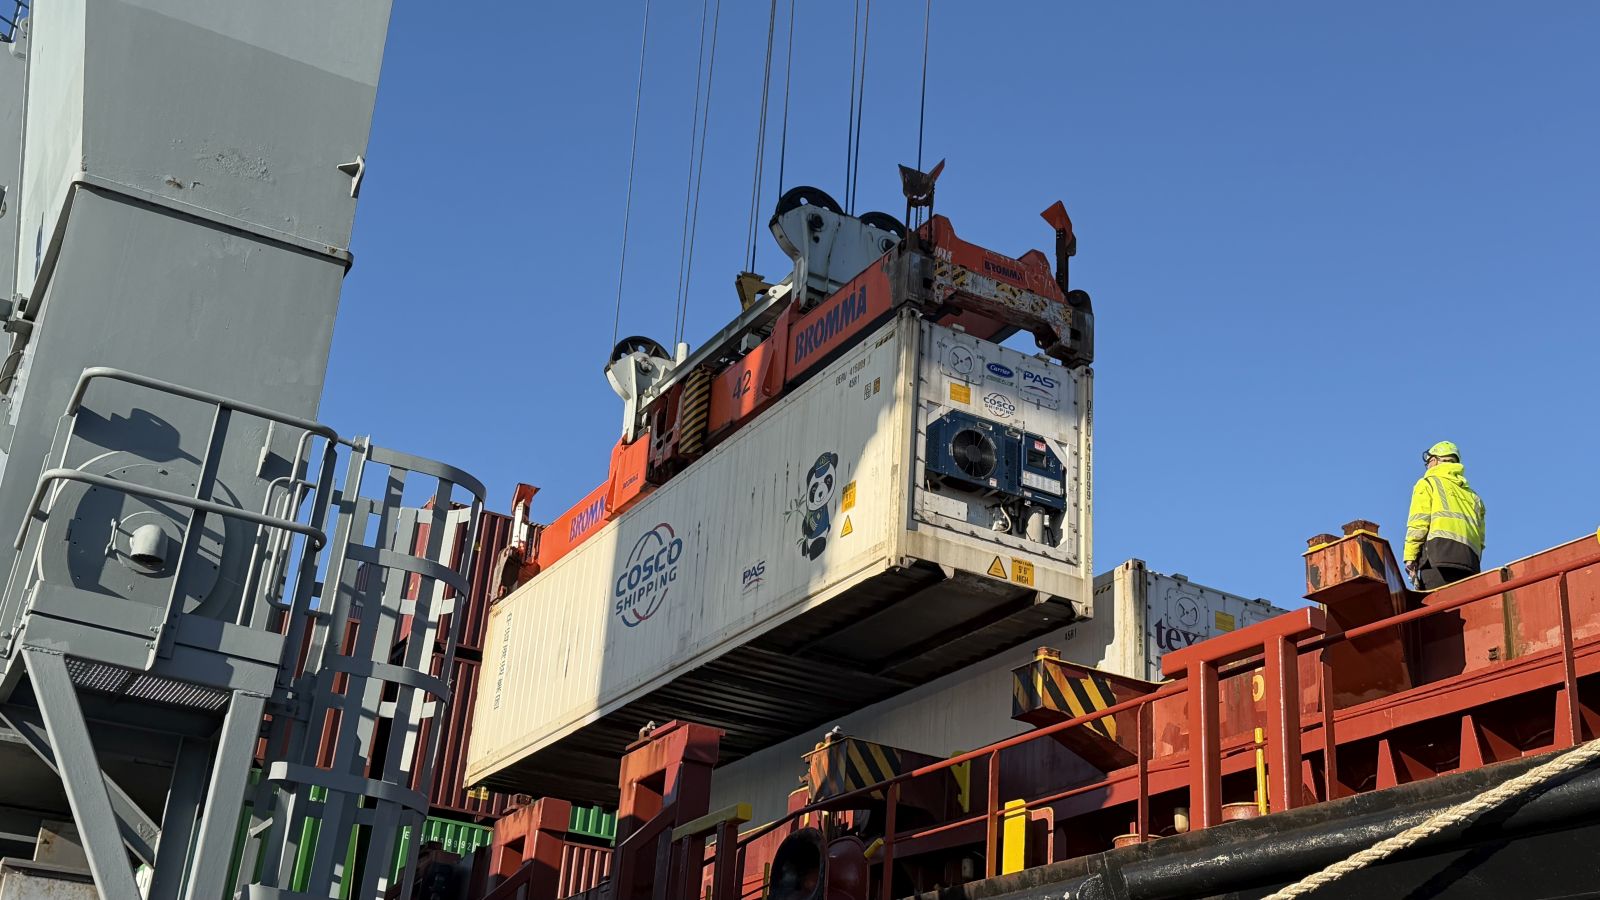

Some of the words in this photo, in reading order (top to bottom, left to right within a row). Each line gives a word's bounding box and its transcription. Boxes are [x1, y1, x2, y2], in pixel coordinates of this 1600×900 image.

[984, 260, 1024, 281] BROMMA
[795, 285, 867, 365] BROMMA
[989, 364, 1011, 375] Carrier
[1023, 371, 1054, 389] PAS
[732, 369, 751, 400] 42
[983, 397, 1016, 411] COSCO
[984, 404, 1015, 416] SHIPPING
[569, 494, 607, 543] BROMM
[615, 538, 683, 598] COSCO
[742, 560, 766, 584] PAS
[615, 566, 678, 616] SHIPPING
